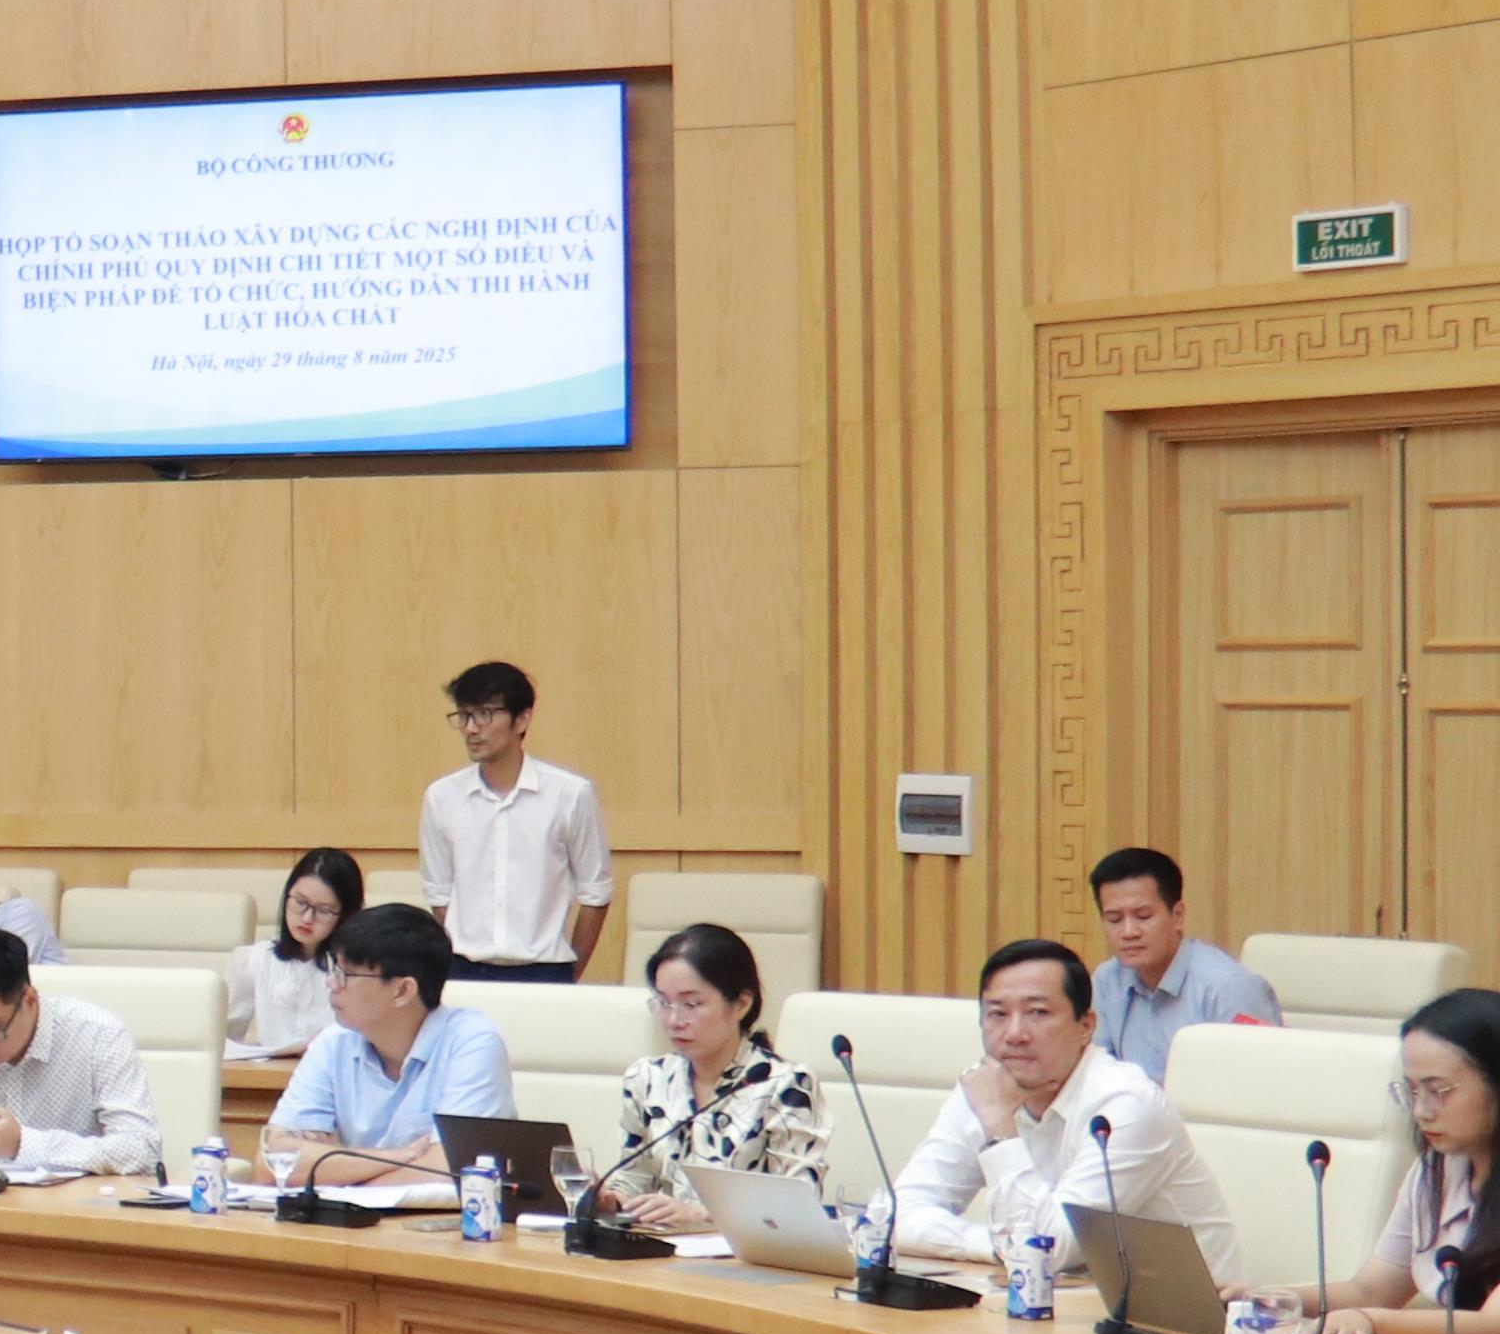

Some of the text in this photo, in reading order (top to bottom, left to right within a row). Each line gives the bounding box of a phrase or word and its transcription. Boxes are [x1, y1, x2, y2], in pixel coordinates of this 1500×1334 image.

[196, 151, 395, 178] BỘ CÔNG THƯƠNG
[51, 232, 83, 254] TỔ
[89, 232, 152, 255] SOẠN
[157, 226, 227, 249] THẢO
[234, 223, 283, 246] XÂY
[290, 223, 360, 247] DỰNG
[367, 218, 419, 241] CÁC
[426, 218, 488, 241] NGHỊ
[496, 216, 558, 240] ĐỊNH
[565, 210, 618, 233] CỦA
[1317, 217, 1374, 242] EXIT
[18, 239, 594, 282] CHÍNH PHỦ QUY ĐỊNH CHI TIẾT MỘT SỐ ĐIỀU VÀ
[1311, 238, 1381, 260] LỐI THOÁT
[23, 272, 591, 313] BIỆN PHÁP ĐỂ TỔ CHỨC, HƯỚNG DẪN THI HÀNH
[204, 304, 401, 333] LUẬT HÓA CHẤT
[151, 346, 457, 374] Hà Nội, ngày 29 tháng 8 năm 2025
